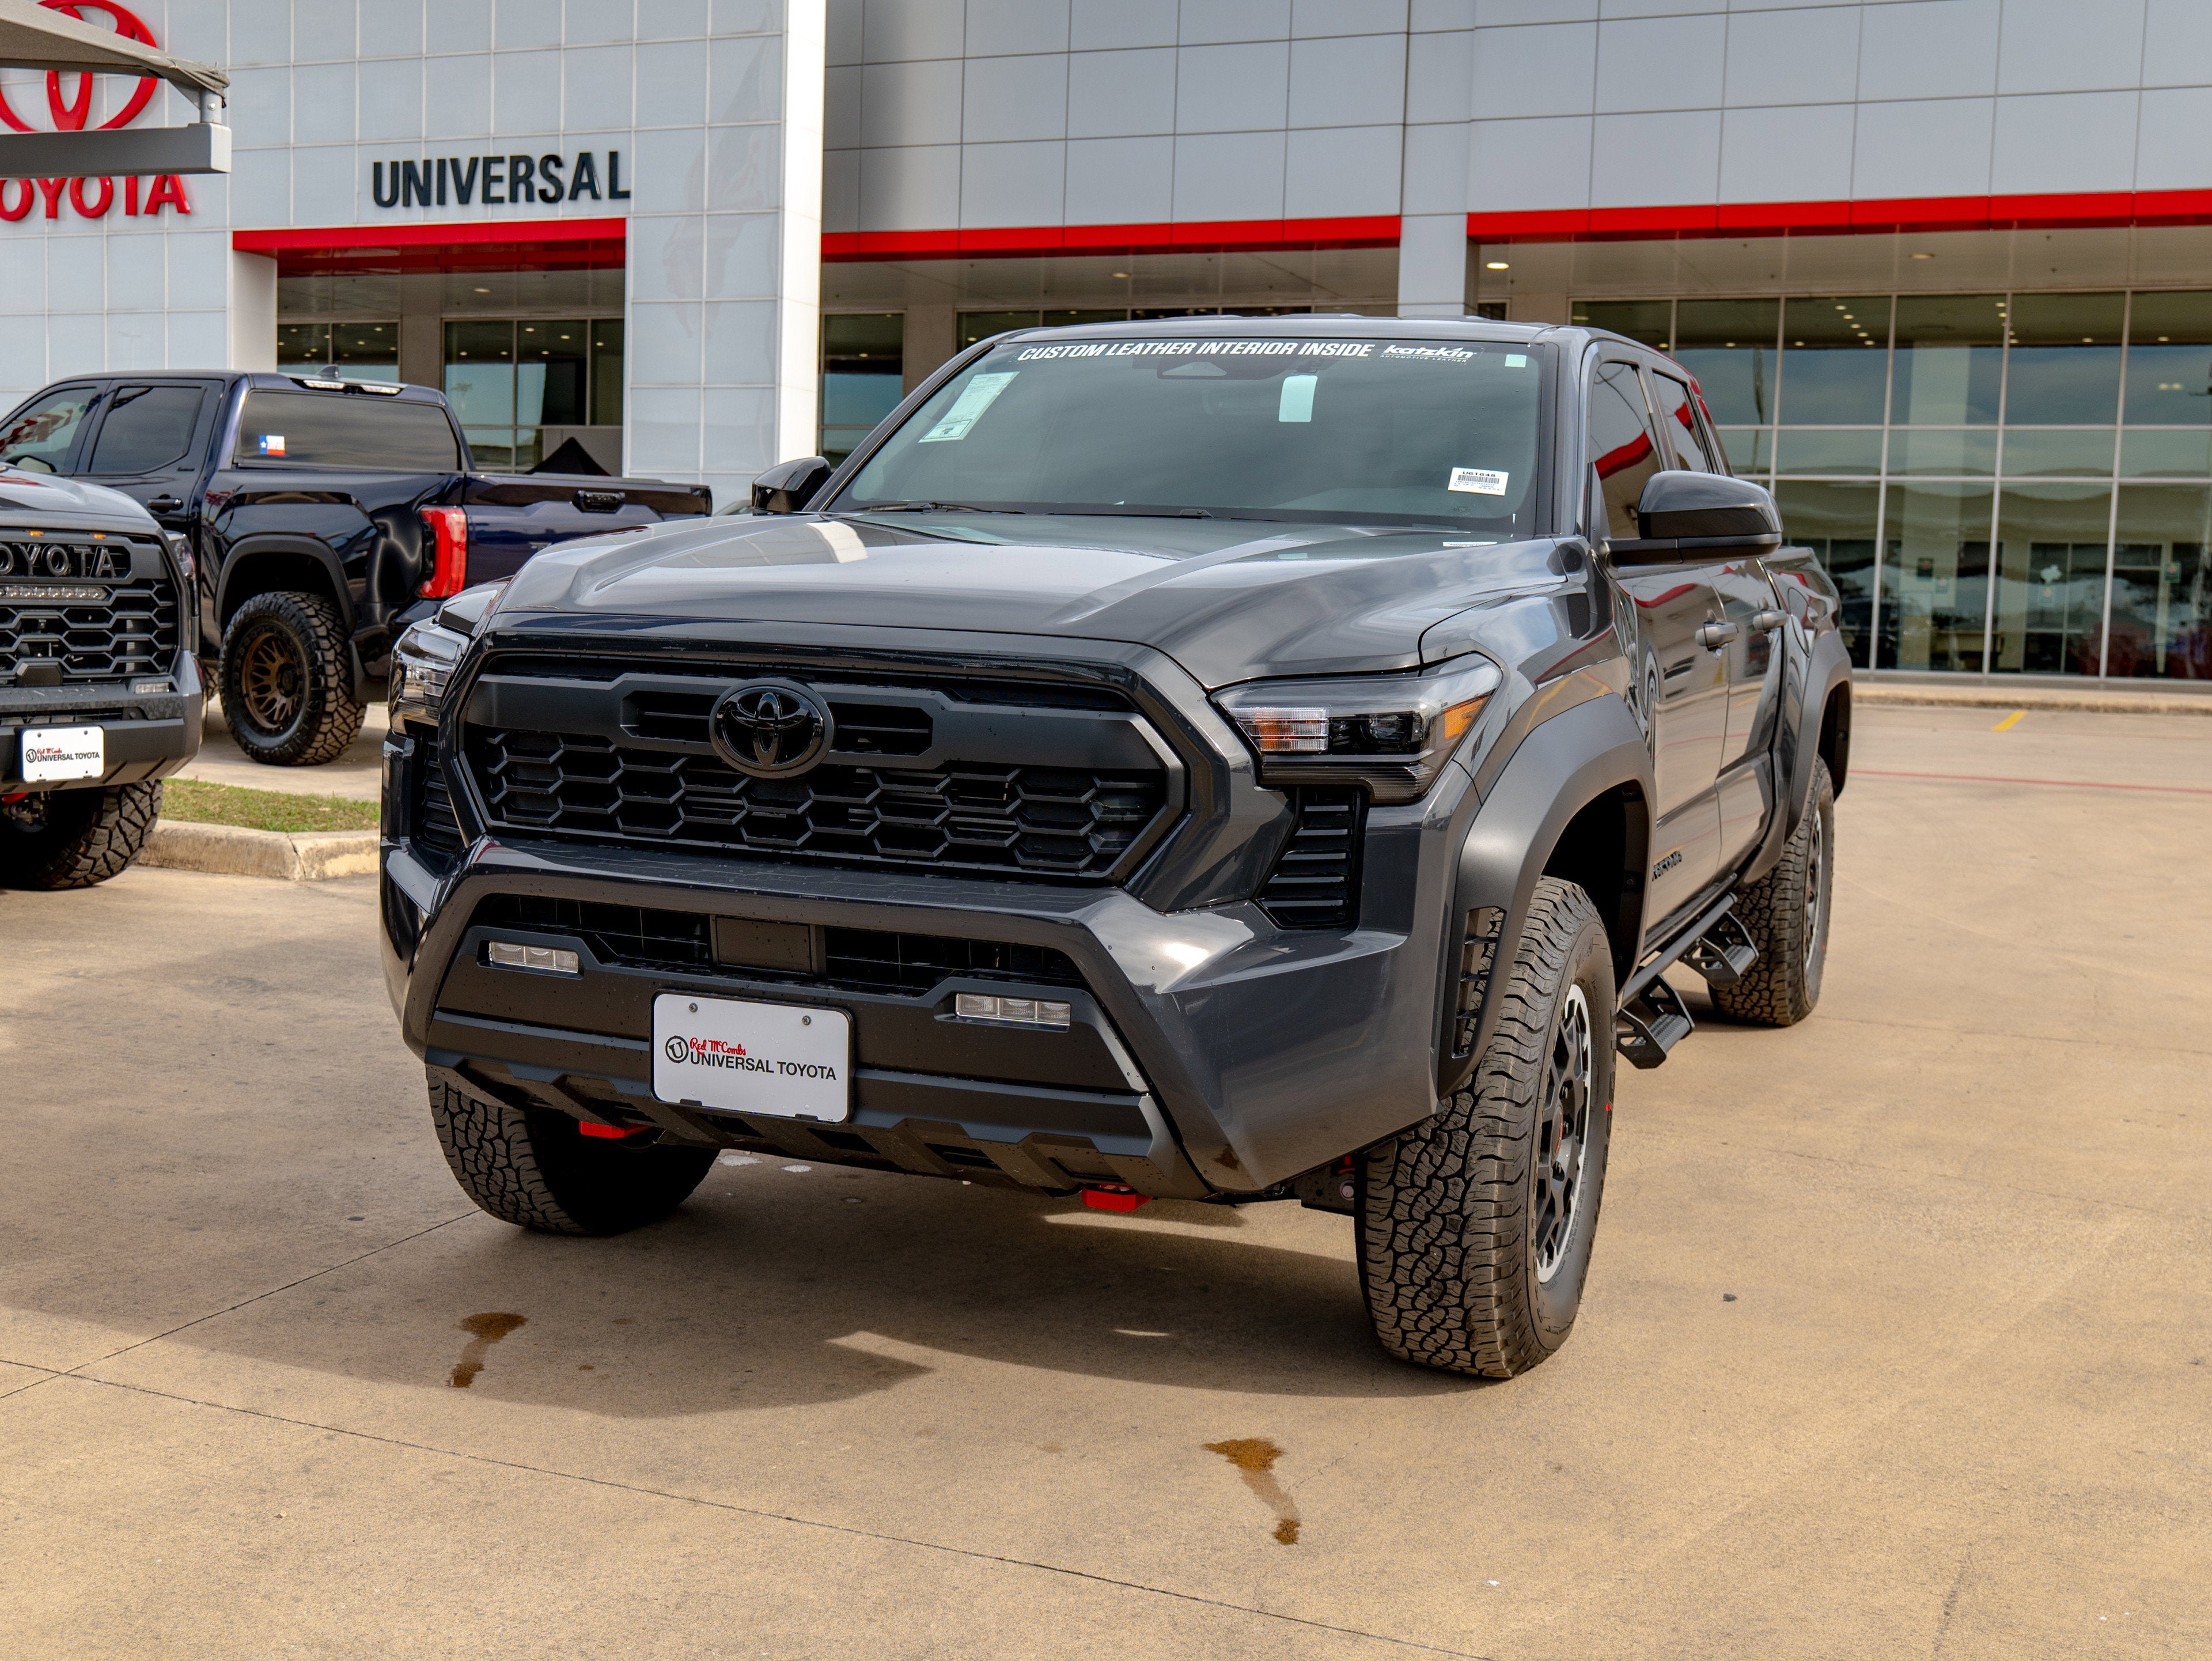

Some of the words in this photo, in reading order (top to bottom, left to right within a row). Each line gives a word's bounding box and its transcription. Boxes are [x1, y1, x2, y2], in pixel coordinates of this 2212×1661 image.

[372, 150, 631, 208] UNIVERSAL
[1017, 344, 1107, 361] CUSTOM
[1105, 342, 1195, 356] LEATHER
[1195, 342, 1298, 355] INTERIOR
[1297, 342, 1376, 357] INSIDE
[1382, 345, 1475, 358] katzkin
[37, 753, 74, 762] UNIVERSAL
[690, 1038, 707, 1055] Red
[708, 1039, 747, 1055] McCombs
[691, 1051, 774, 1073] UNIVERSAL
[777, 1061, 836, 1080] TOYOTA
